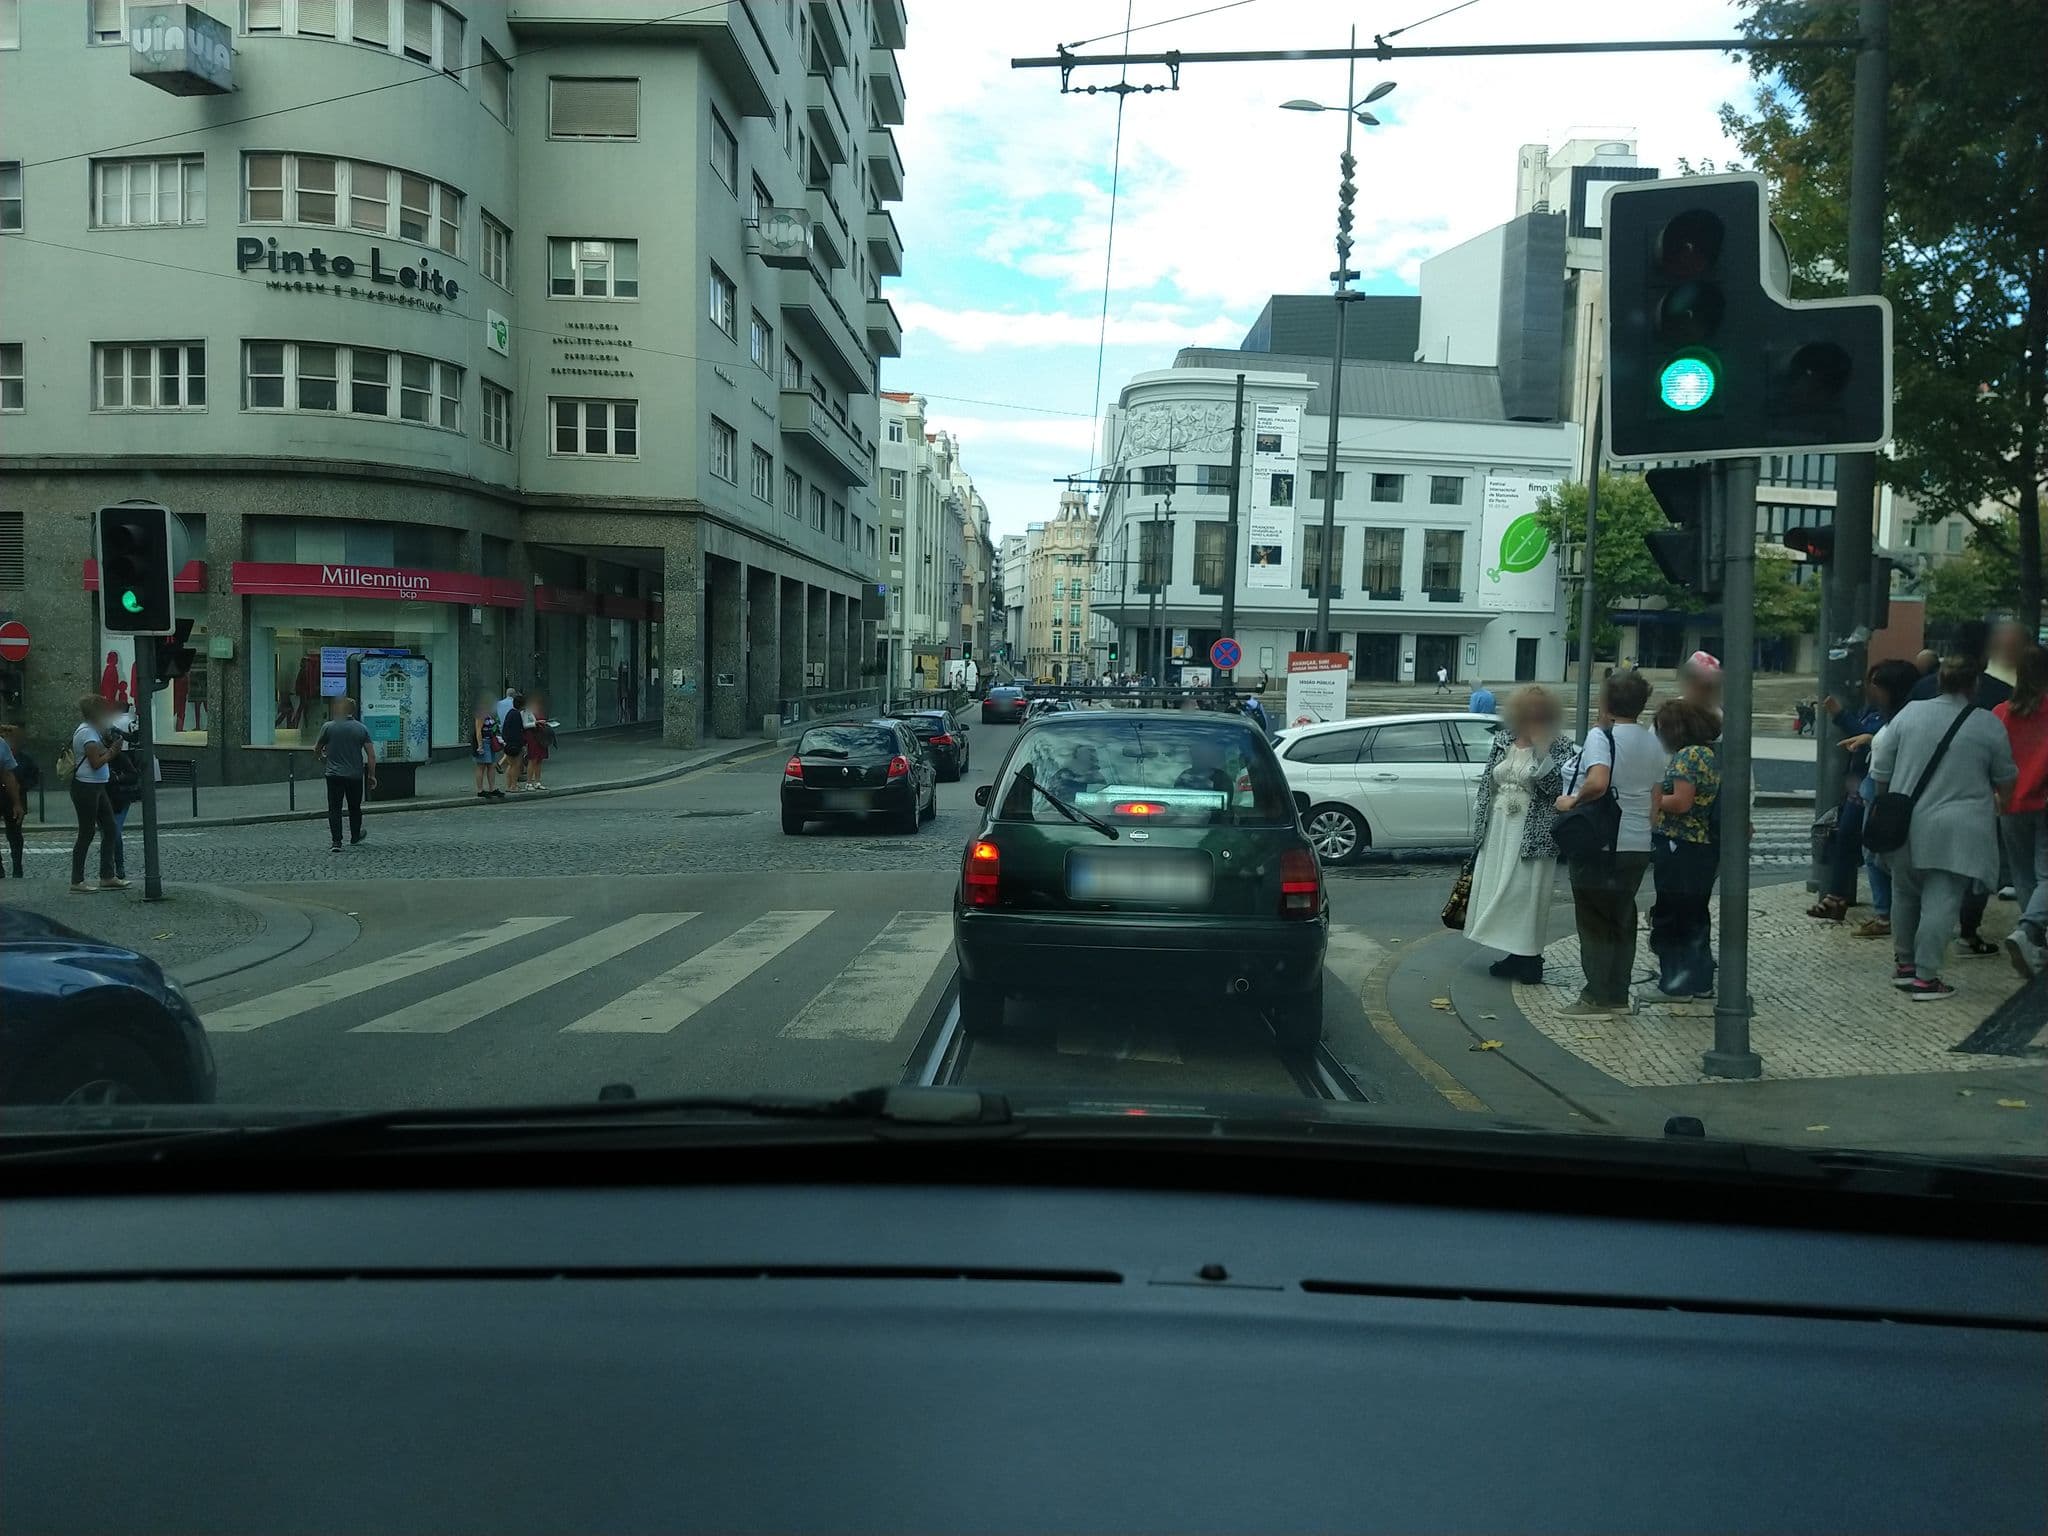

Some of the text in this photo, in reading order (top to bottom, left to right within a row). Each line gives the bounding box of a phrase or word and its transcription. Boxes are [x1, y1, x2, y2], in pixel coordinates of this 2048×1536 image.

[236, 236, 459, 300] Pinto Leite
[265, 280, 325, 292] IMAGEM
[334, 285, 342, 295] E
[1528, 483, 1547, 493] fimp
[321, 565, 430, 589] Millennium
[400, 589, 417, 600] bcp
